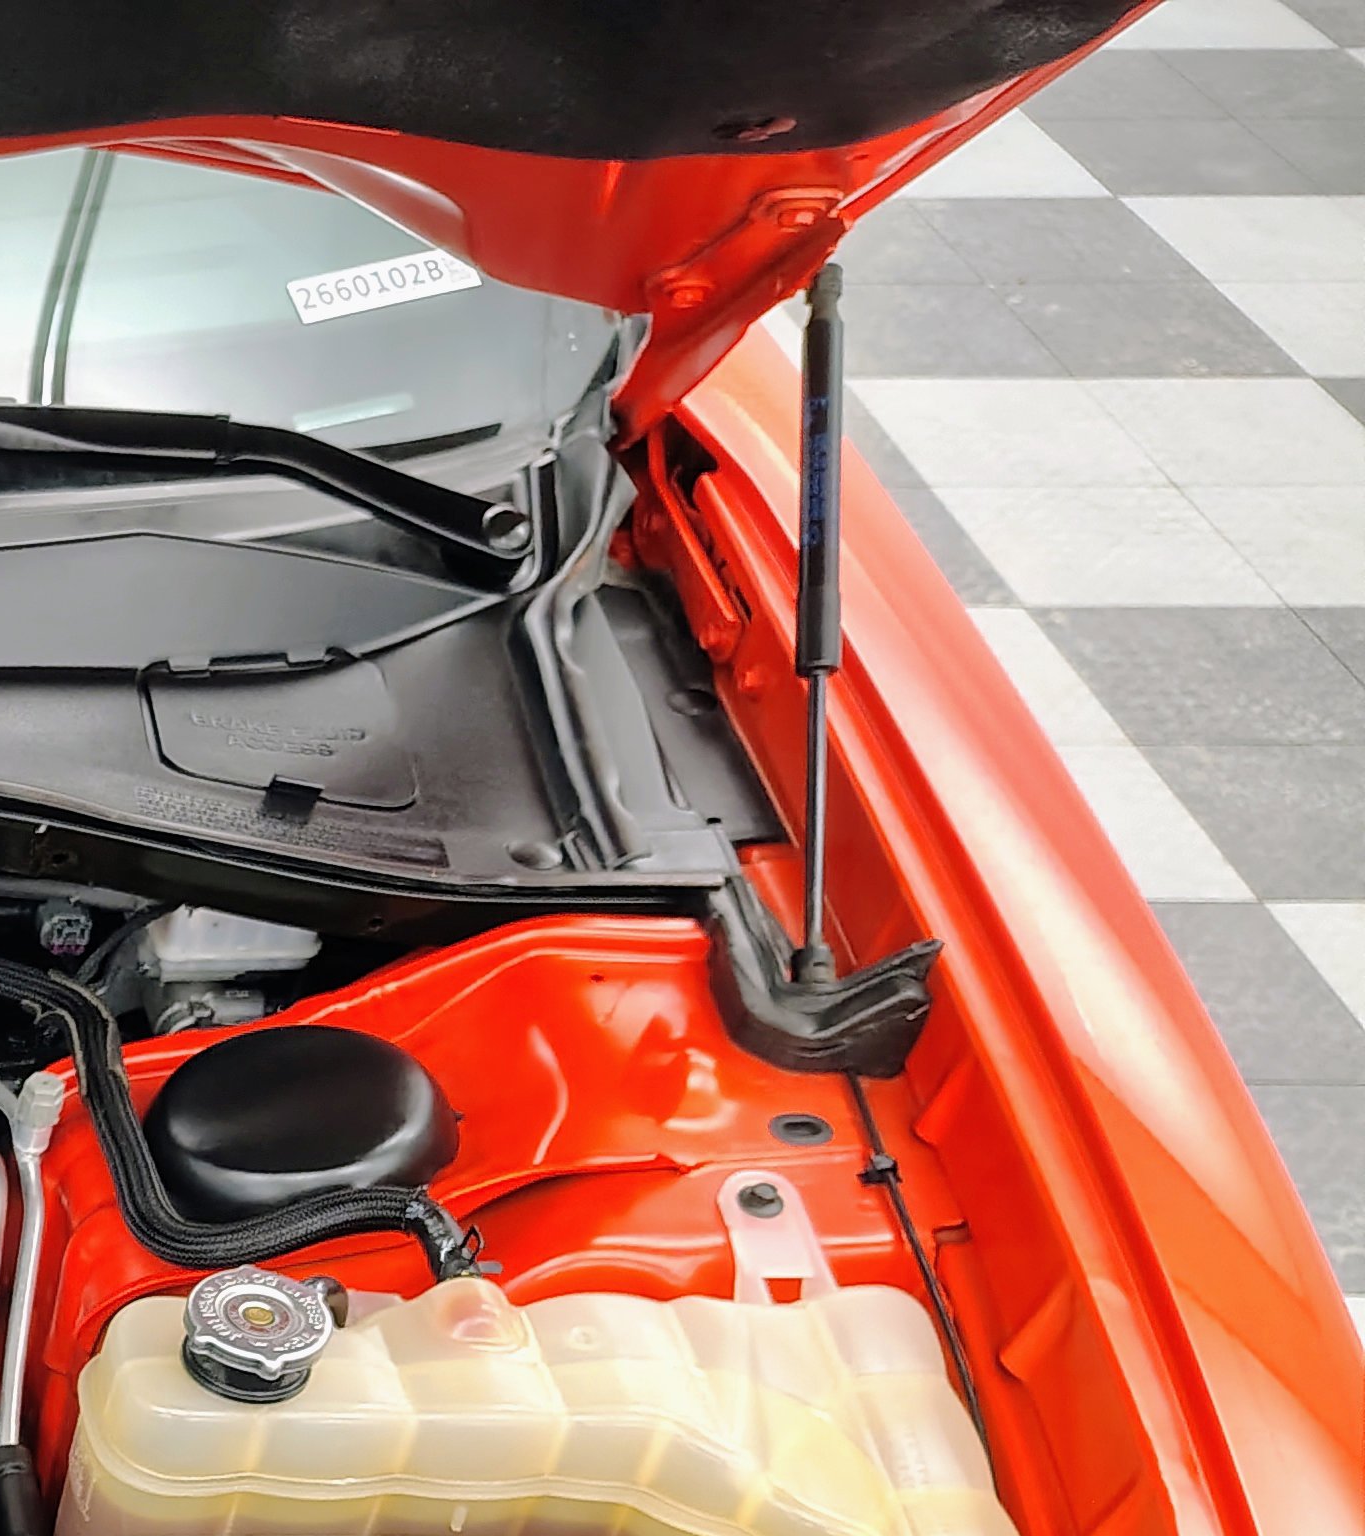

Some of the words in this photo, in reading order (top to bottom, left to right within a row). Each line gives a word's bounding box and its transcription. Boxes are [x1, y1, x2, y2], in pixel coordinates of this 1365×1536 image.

[296, 259, 444, 310] 2660102B
[190, 711, 280, 735] BRAKE
[227, 734, 334, 757] ACCESS
